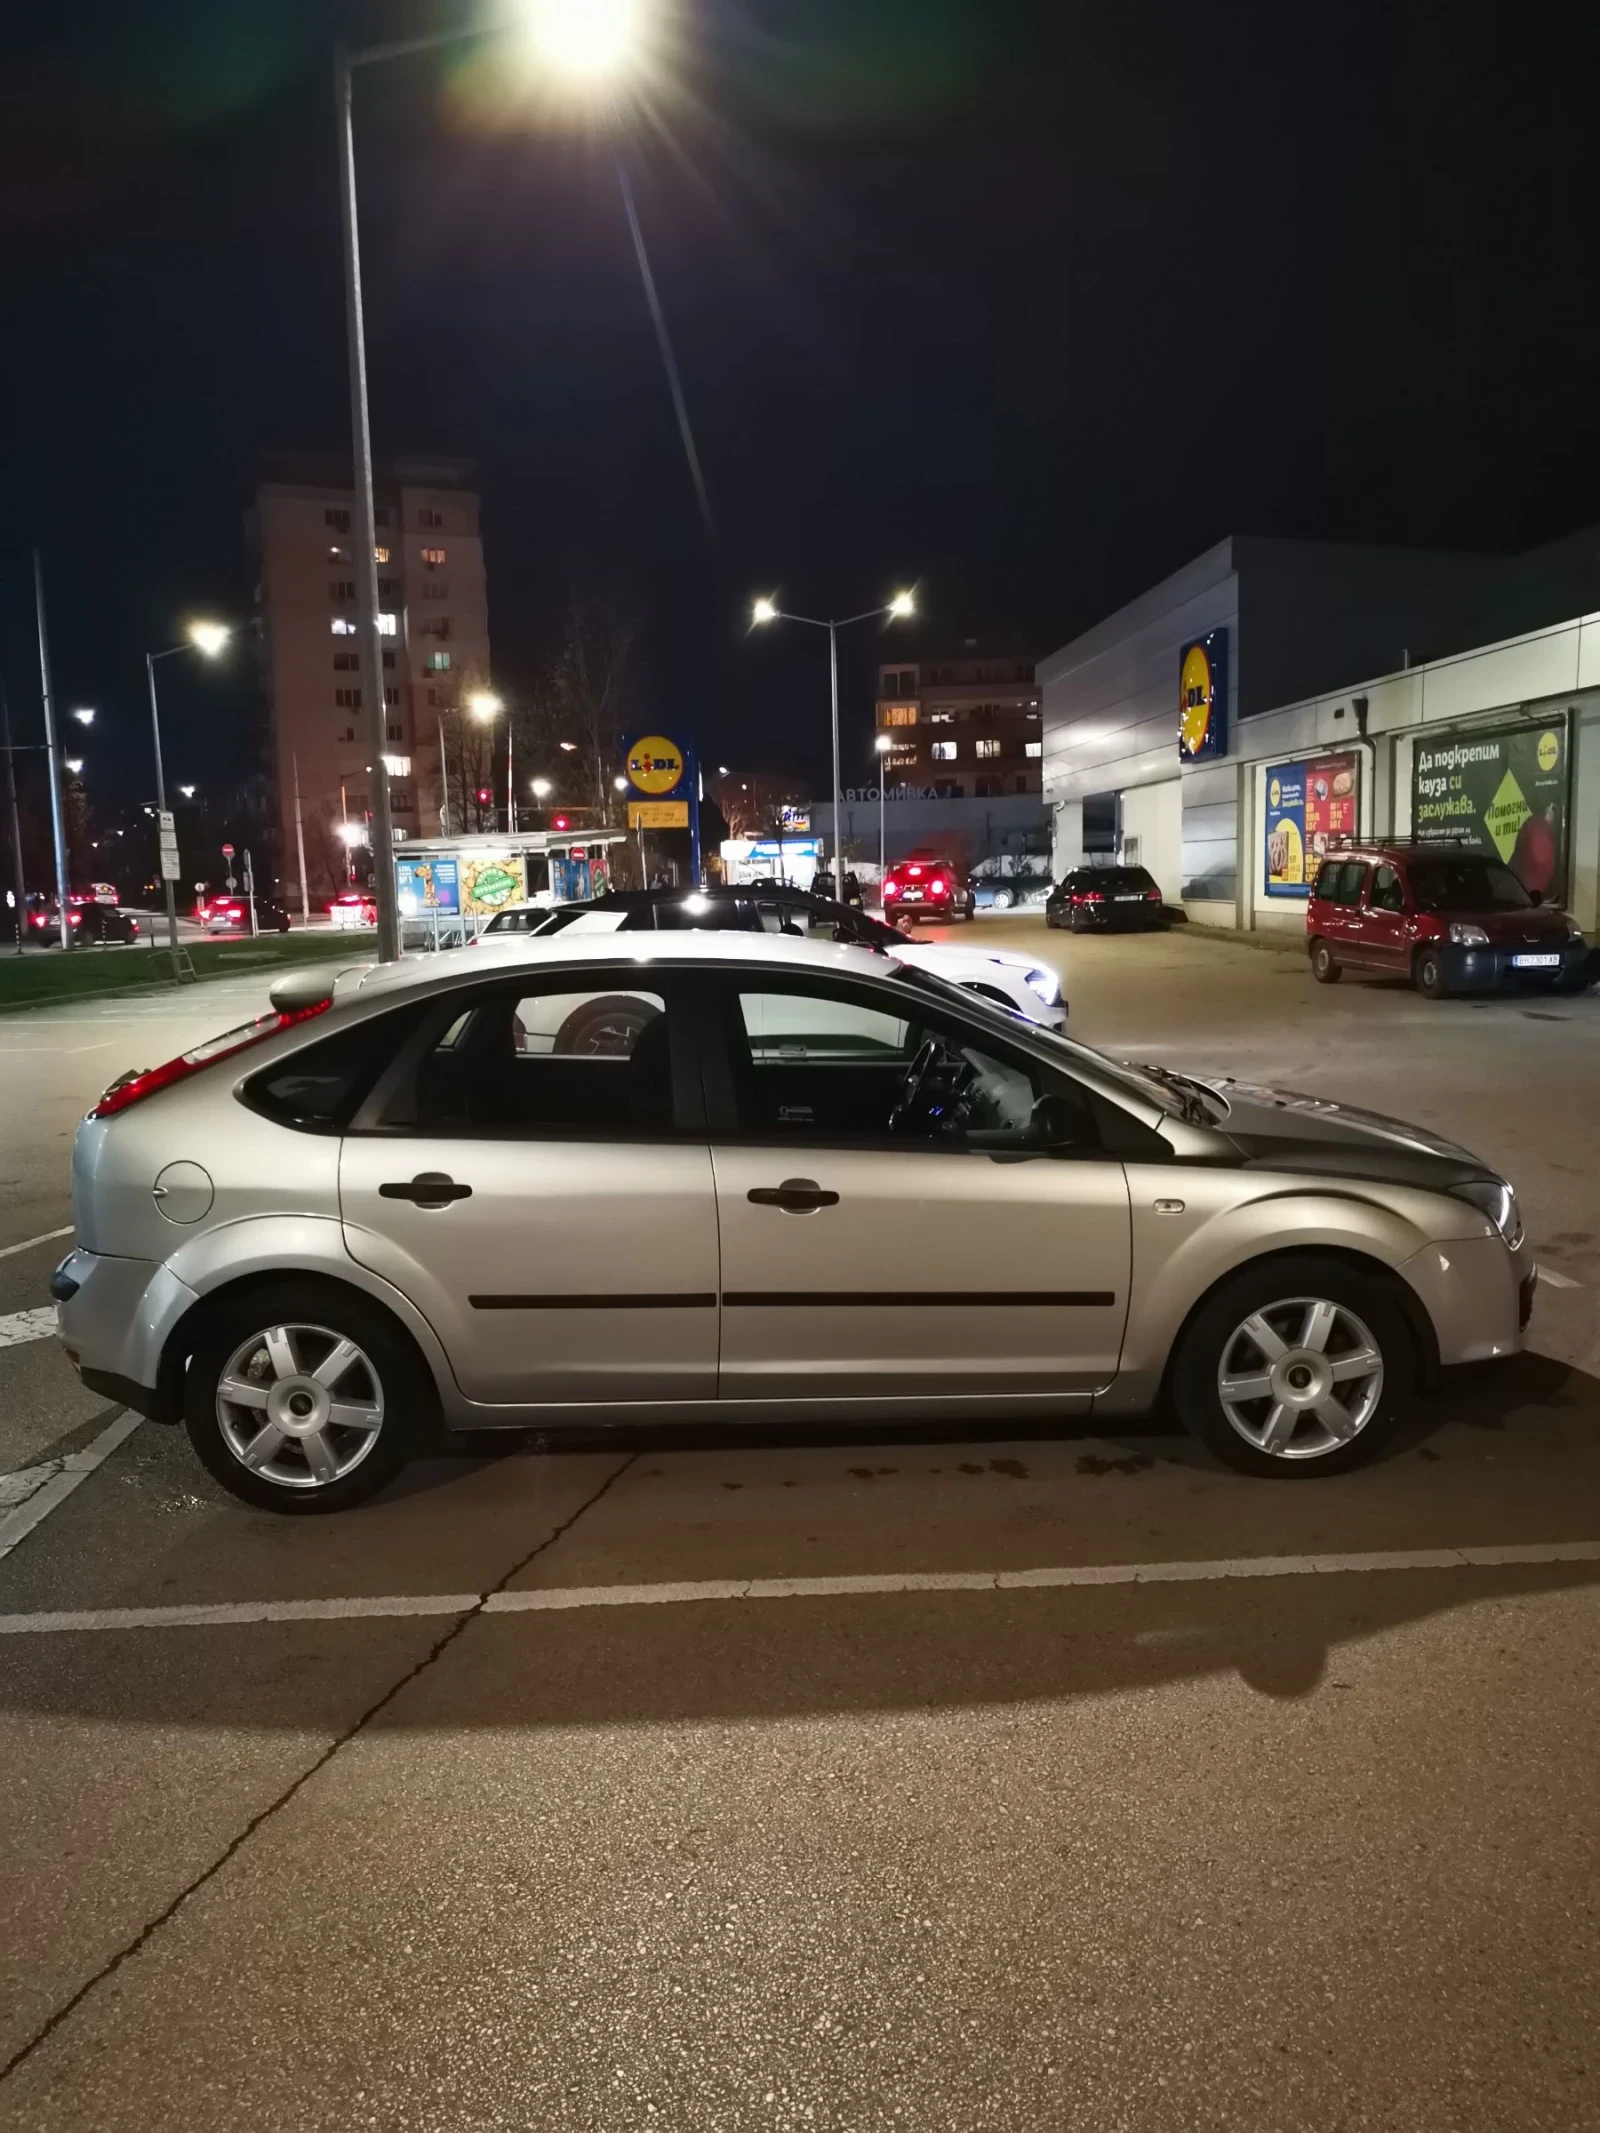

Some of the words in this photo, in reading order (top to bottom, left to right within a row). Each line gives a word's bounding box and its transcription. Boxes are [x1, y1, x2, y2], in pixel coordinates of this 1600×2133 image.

[1182, 680, 1207, 709] IDL
[630, 753, 679, 773] LIDL
[1418, 751, 1433, 773] Да
[1434, 744, 1499, 768] подкрепим
[838, 785, 938, 802] АВТОМИВКА
[1418, 775, 1447, 796] кауза
[1449, 774, 1462, 790] си
[1418, 794, 1476, 823] заслужава.
[1487, 801, 1528, 820] Помогни
[1495, 825, 1502, 837] и
[1502, 818, 1521, 835] ти!
